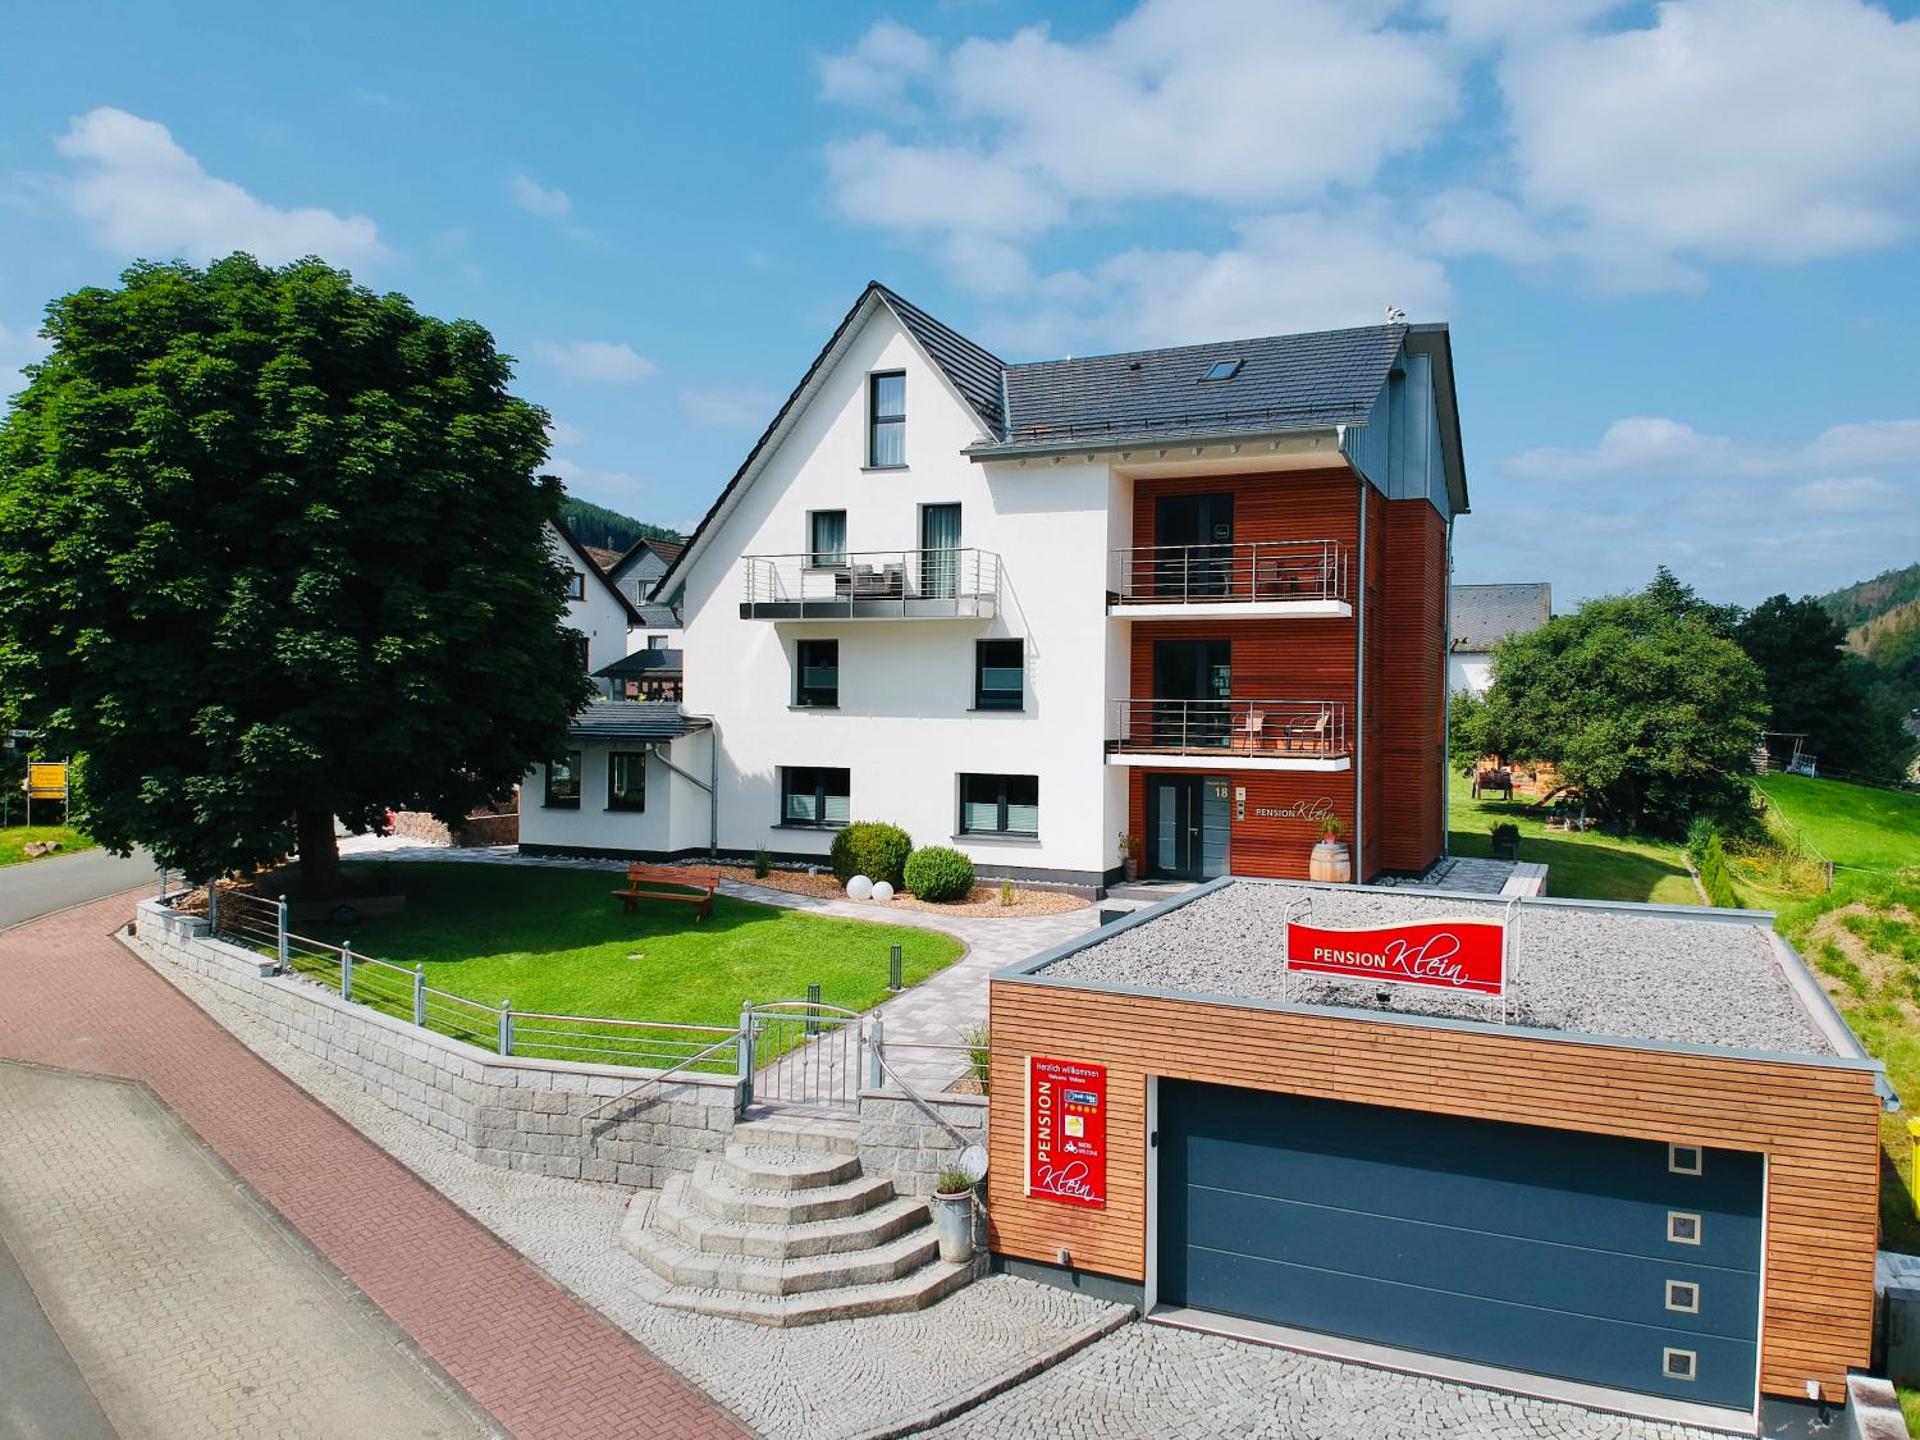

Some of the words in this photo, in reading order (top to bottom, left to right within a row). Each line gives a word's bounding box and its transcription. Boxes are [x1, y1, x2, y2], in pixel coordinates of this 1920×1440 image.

[1216, 787, 1228, 798] 18
[1256, 808, 1295, 818] PENSION
[1314, 947, 1386, 969] PENSION
[1385, 933, 1469, 984] Klein
[1038, 1081, 1051, 1162] PENSION
[1038, 1160, 1095, 1201] Klein
